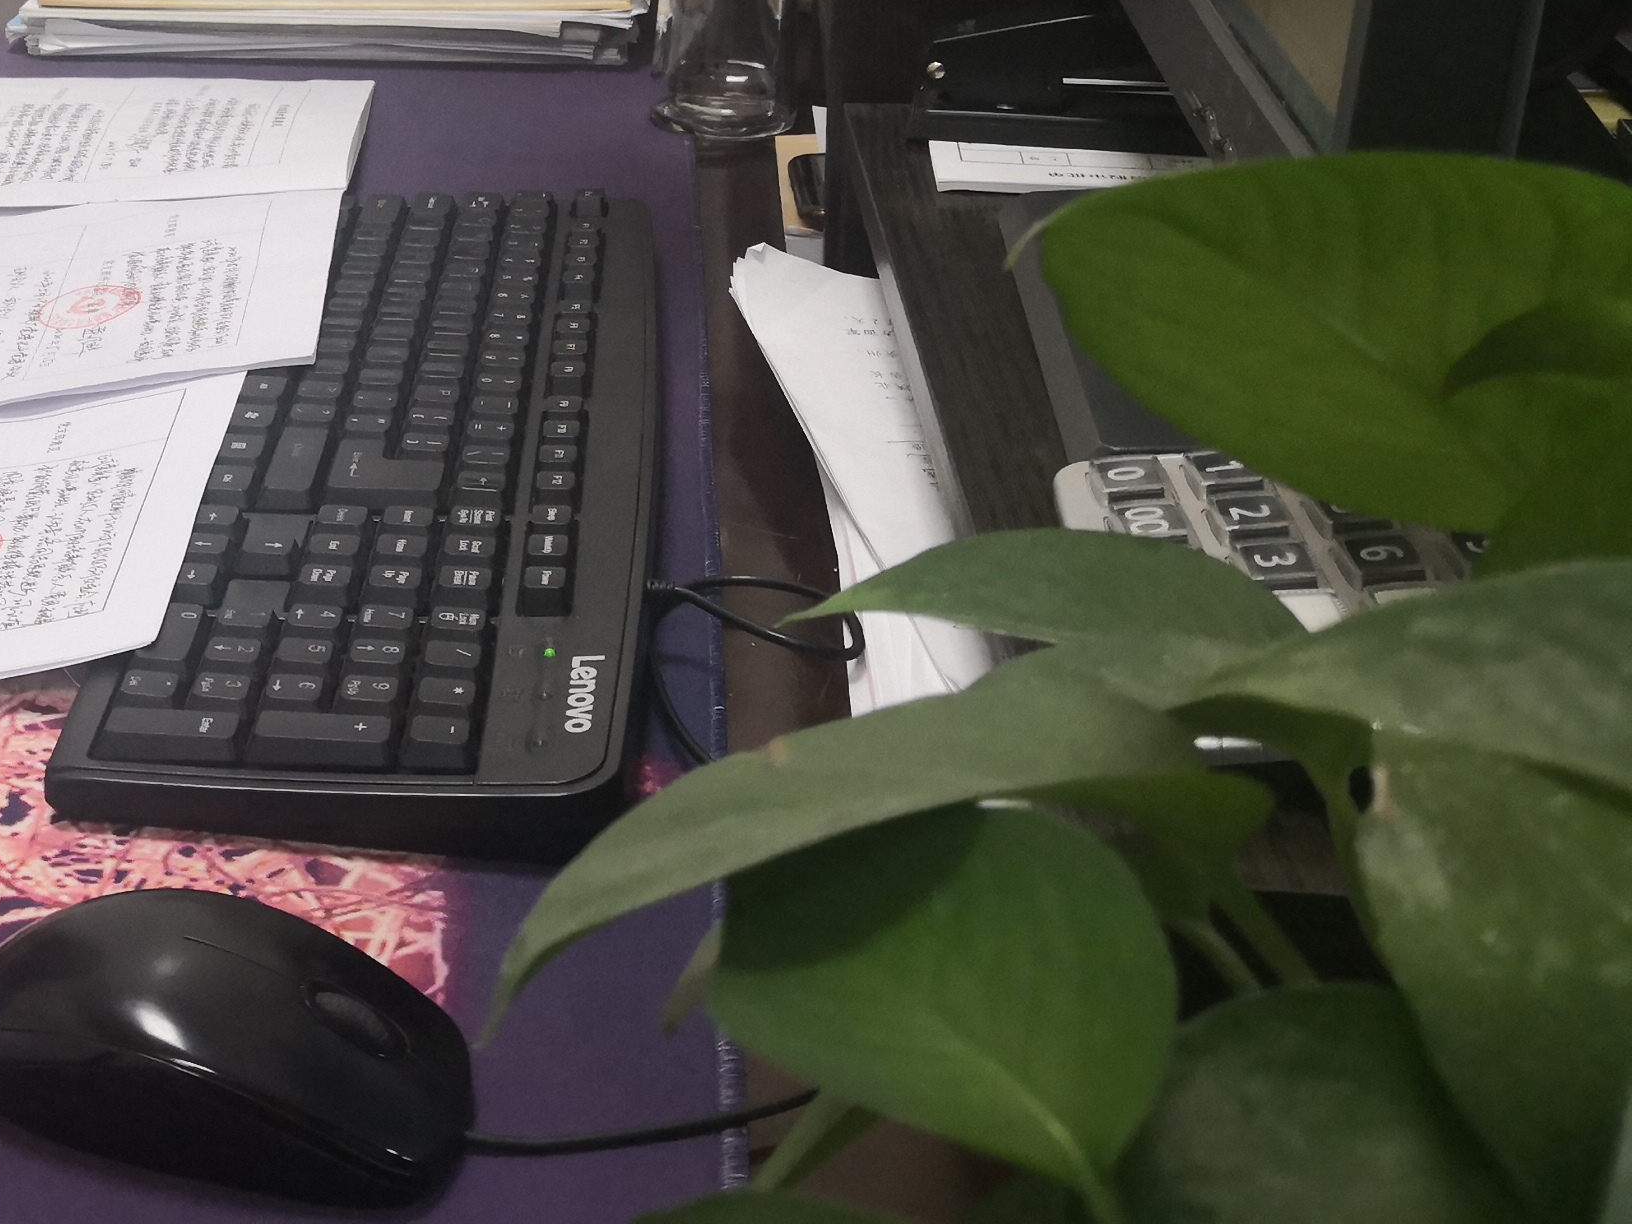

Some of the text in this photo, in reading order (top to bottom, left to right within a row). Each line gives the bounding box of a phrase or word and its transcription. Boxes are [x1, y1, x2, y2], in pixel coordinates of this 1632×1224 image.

[1107, 466, 1145, 481] 0
[1204, 459, 1245, 473] 1
[1228, 504, 1272, 522] 2
[1252, 551, 1298, 568] 3
[1359, 545, 1405, 562] 6
[564, 654, 606, 733] Lenovo
